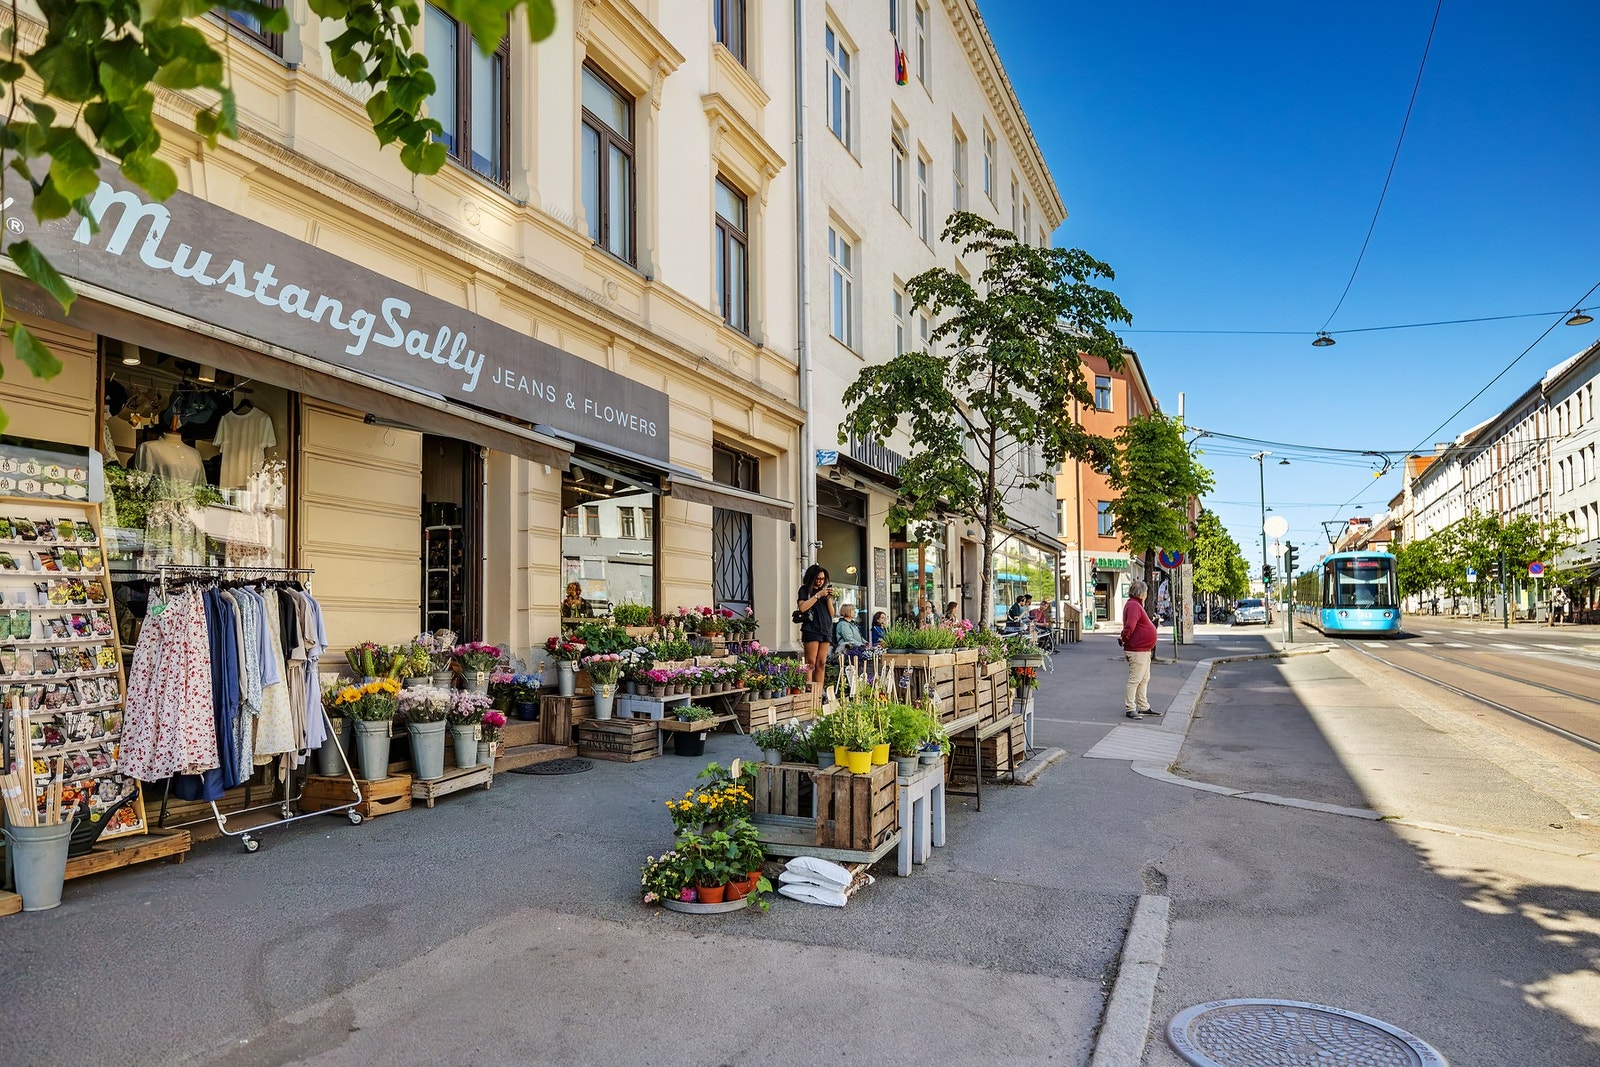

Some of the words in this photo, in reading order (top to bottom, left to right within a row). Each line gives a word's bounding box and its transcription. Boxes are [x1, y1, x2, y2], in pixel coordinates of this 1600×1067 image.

[492, 367, 556, 403] JEANS
[565, 392, 577, 410] &
[584, 398, 658, 438] FLOWERS
